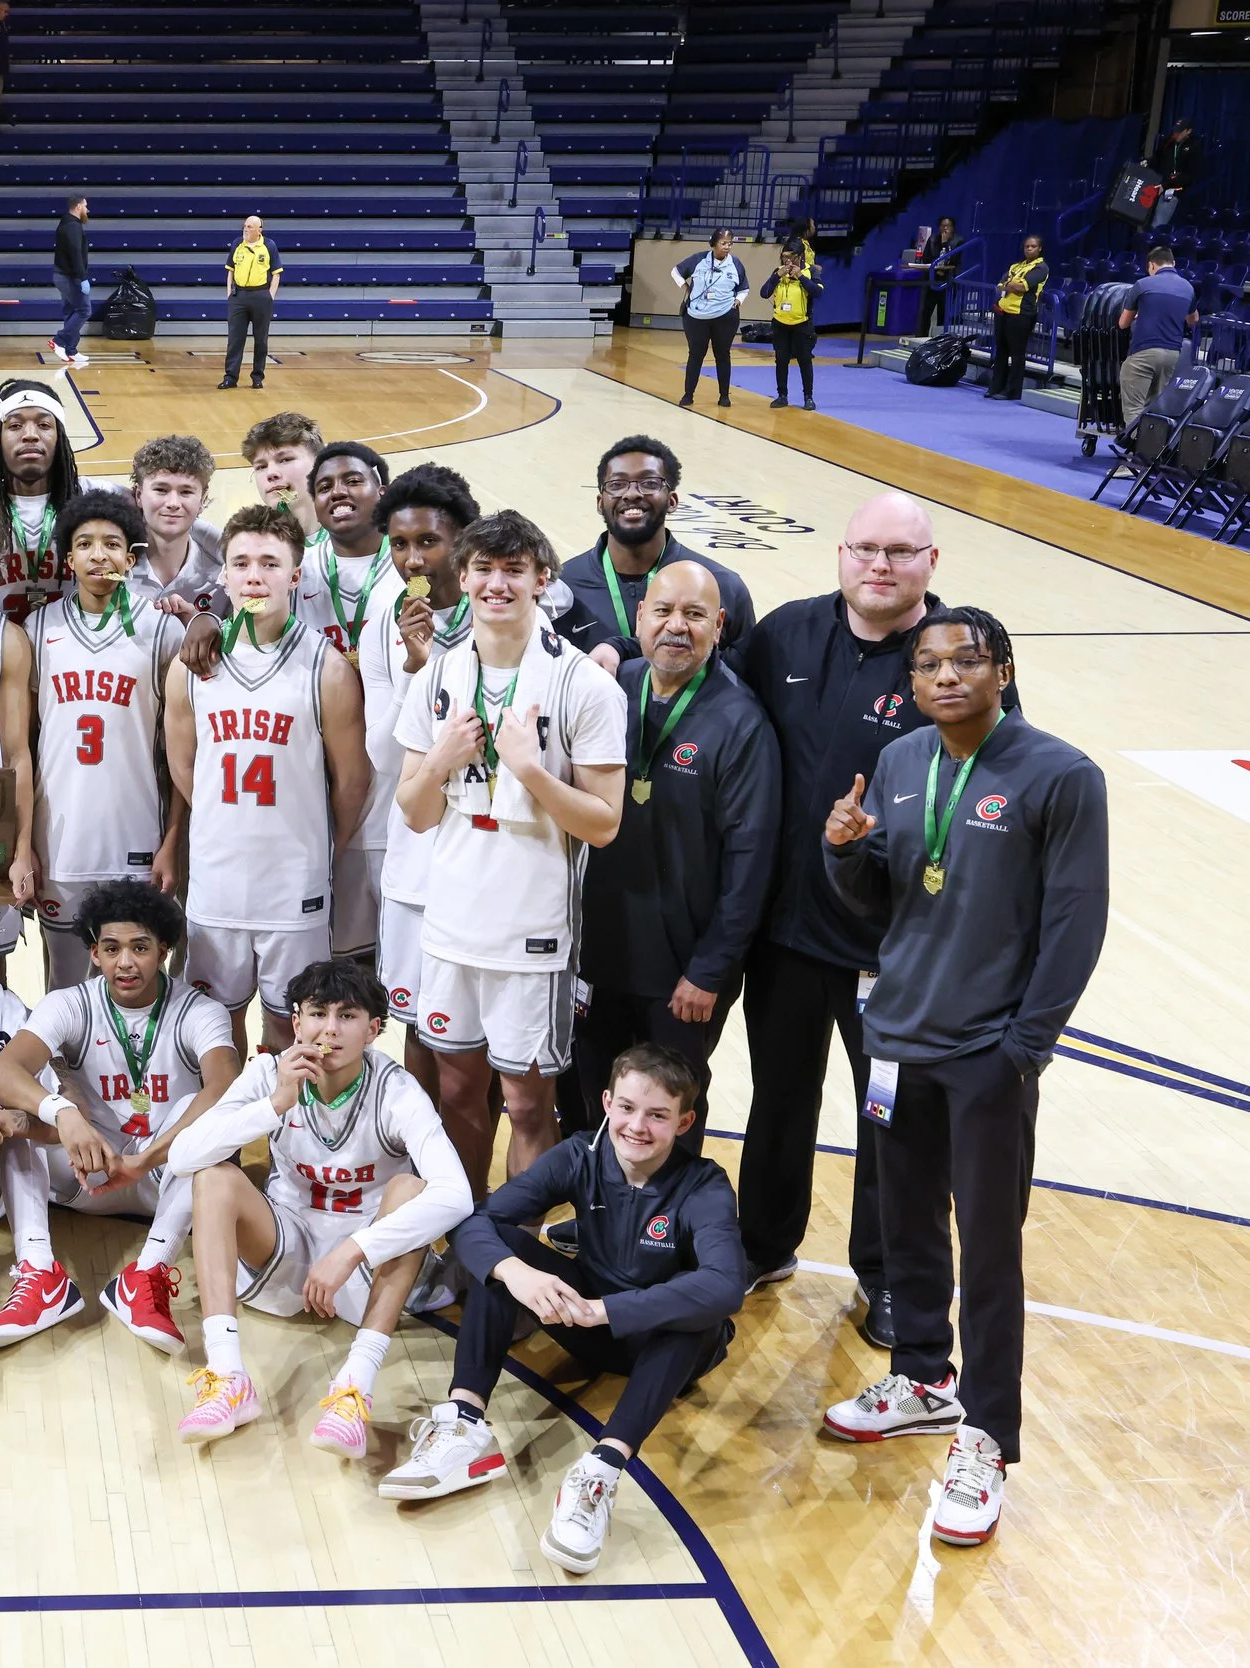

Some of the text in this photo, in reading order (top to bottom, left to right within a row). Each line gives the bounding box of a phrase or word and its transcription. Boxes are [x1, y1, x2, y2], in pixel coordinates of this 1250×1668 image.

[51, 670, 137, 708] IRISH
[75, 713, 106, 766] 3
[207, 708, 295, 747] IRISH
[220, 751, 277, 807] 14
[965, 818, 1010, 833] BASKETBALL
[639, 1238, 676, 1249] BASKETBALL
